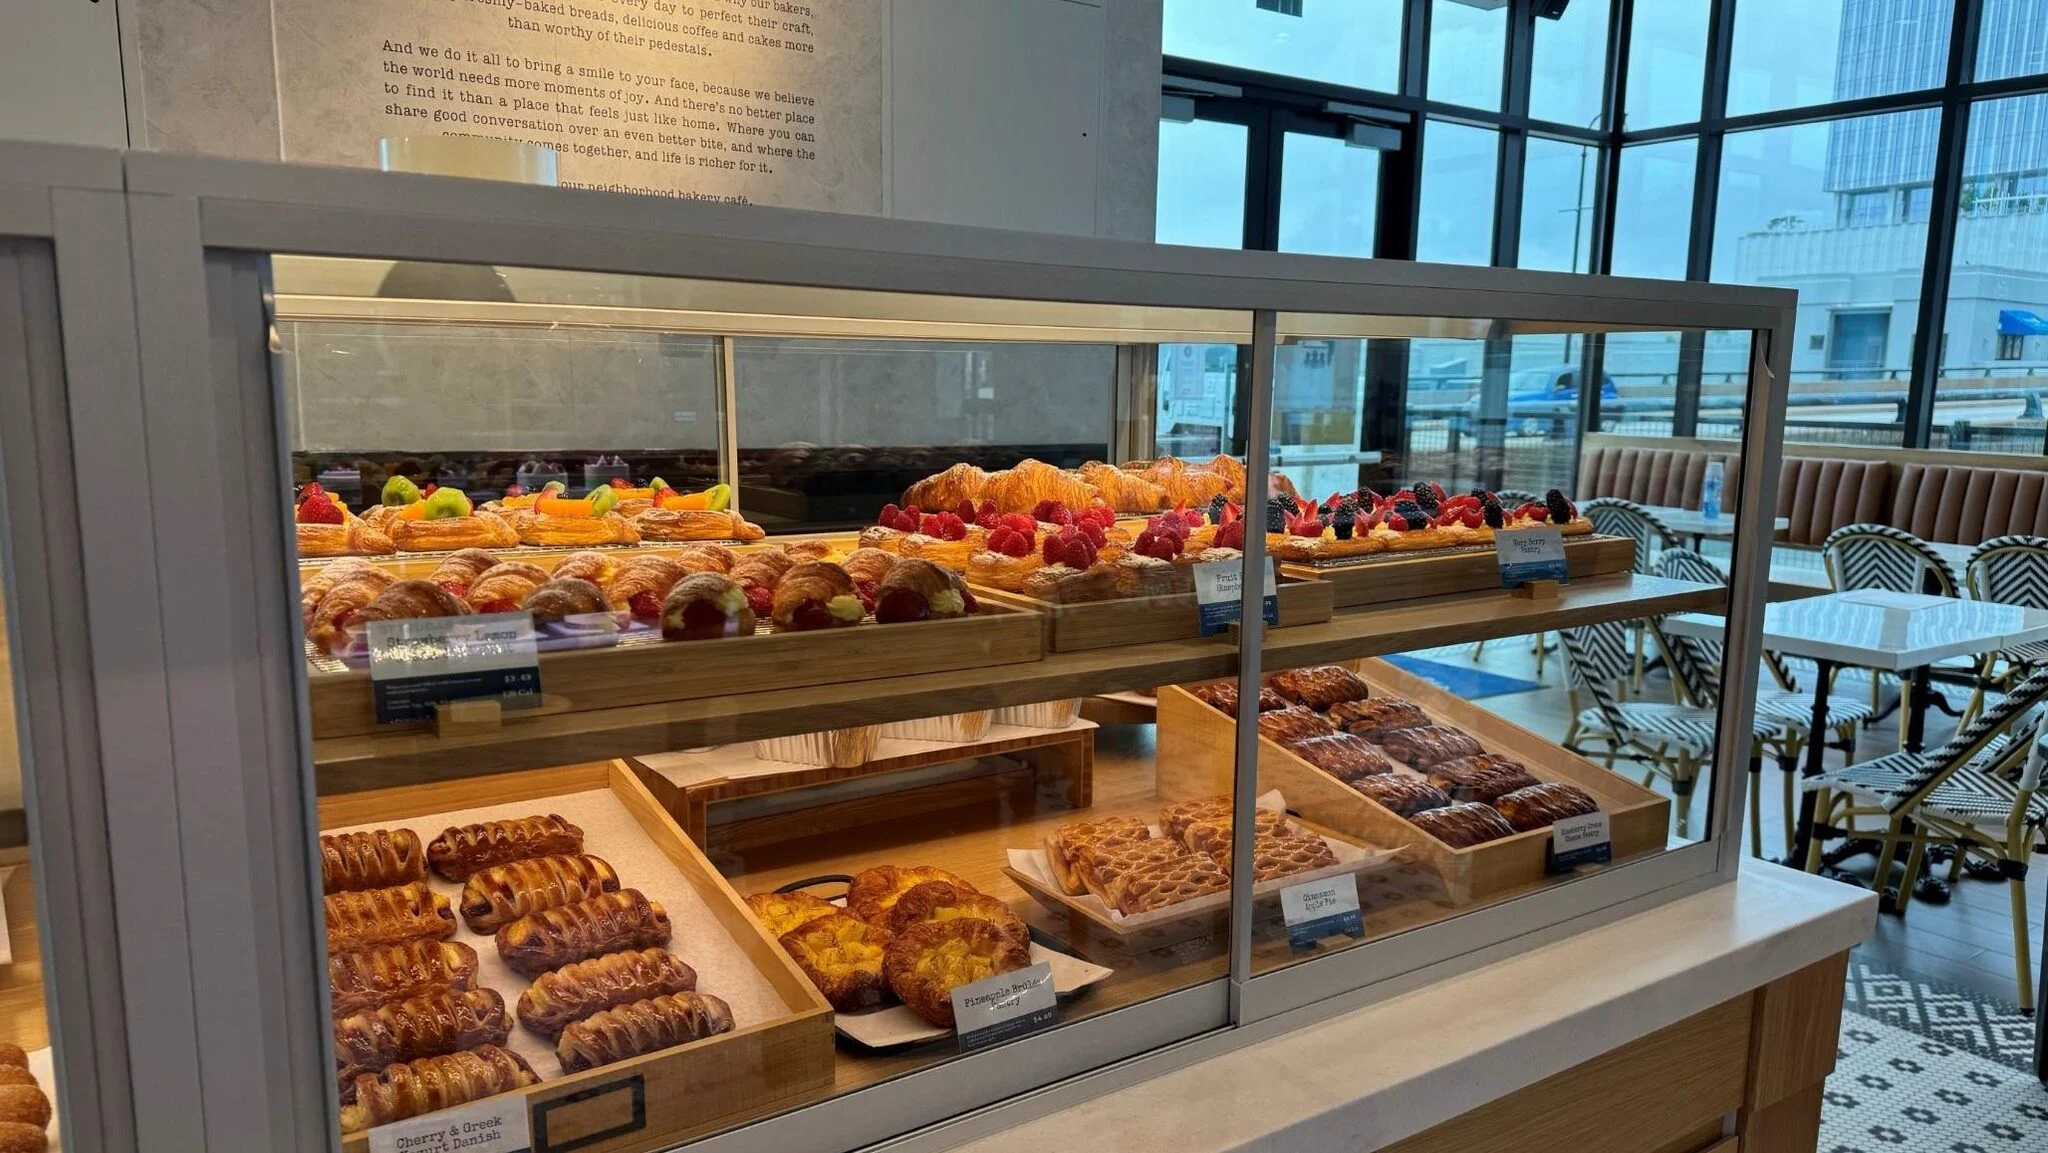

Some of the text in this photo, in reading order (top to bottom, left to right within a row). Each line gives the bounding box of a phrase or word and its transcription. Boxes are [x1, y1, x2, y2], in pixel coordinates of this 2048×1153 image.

[653, 0, 677, 15] day
[682, 4, 694, 16] to
[700, 9, 743, 24] perfect
[748, 15, 778, 29] their
[782, 22, 814, 36] craft,
[751, 0, 771, 9] our
[773, 0, 814, 18] bakers,
[508, 16, 712, 57] than worthy of their pedestals.
[569, 4, 619, 25] breads,
[623, 14, 679, 33] delicious
[682, 25, 718, 39] coffee
[722, 31, 744, 43] and
[748, 34, 782, 48] cakes
[785, 40, 814, 53] more
[382, 39, 815, 107] And we do it all to bring a smile to your face, because we believe
[383, 61, 815, 125] the world needs more moments of joy. And there's no better place
[384, 81, 815, 143] to find it than a place that feels just like home. Where you can
[385, 103, 815, 160] share good conversation over an even better bite, and where the
[573, 142, 632, 160] together,
[635, 149, 658, 162] and
[662, 152, 681, 164] life
[685, 154, 695, 165] is
[699, 156, 736, 170] richer
[739, 160, 756, 172] for
[759, 162, 773, 174] it.
[560, 181, 753, 206] our neighborhood bakery café.
[1216, 574, 1238, 582] Fruit
[475, 629, 517, 642] Lemon
[1303, 889, 1335, 901] Cinnamon
[1305, 898, 1336, 911] Apple Pie
[964, 988, 1010, 1008] Pineapple
[396, 1116, 502, 1149] Cherry & Greek
[453, 1130, 501, 1149] Danish
